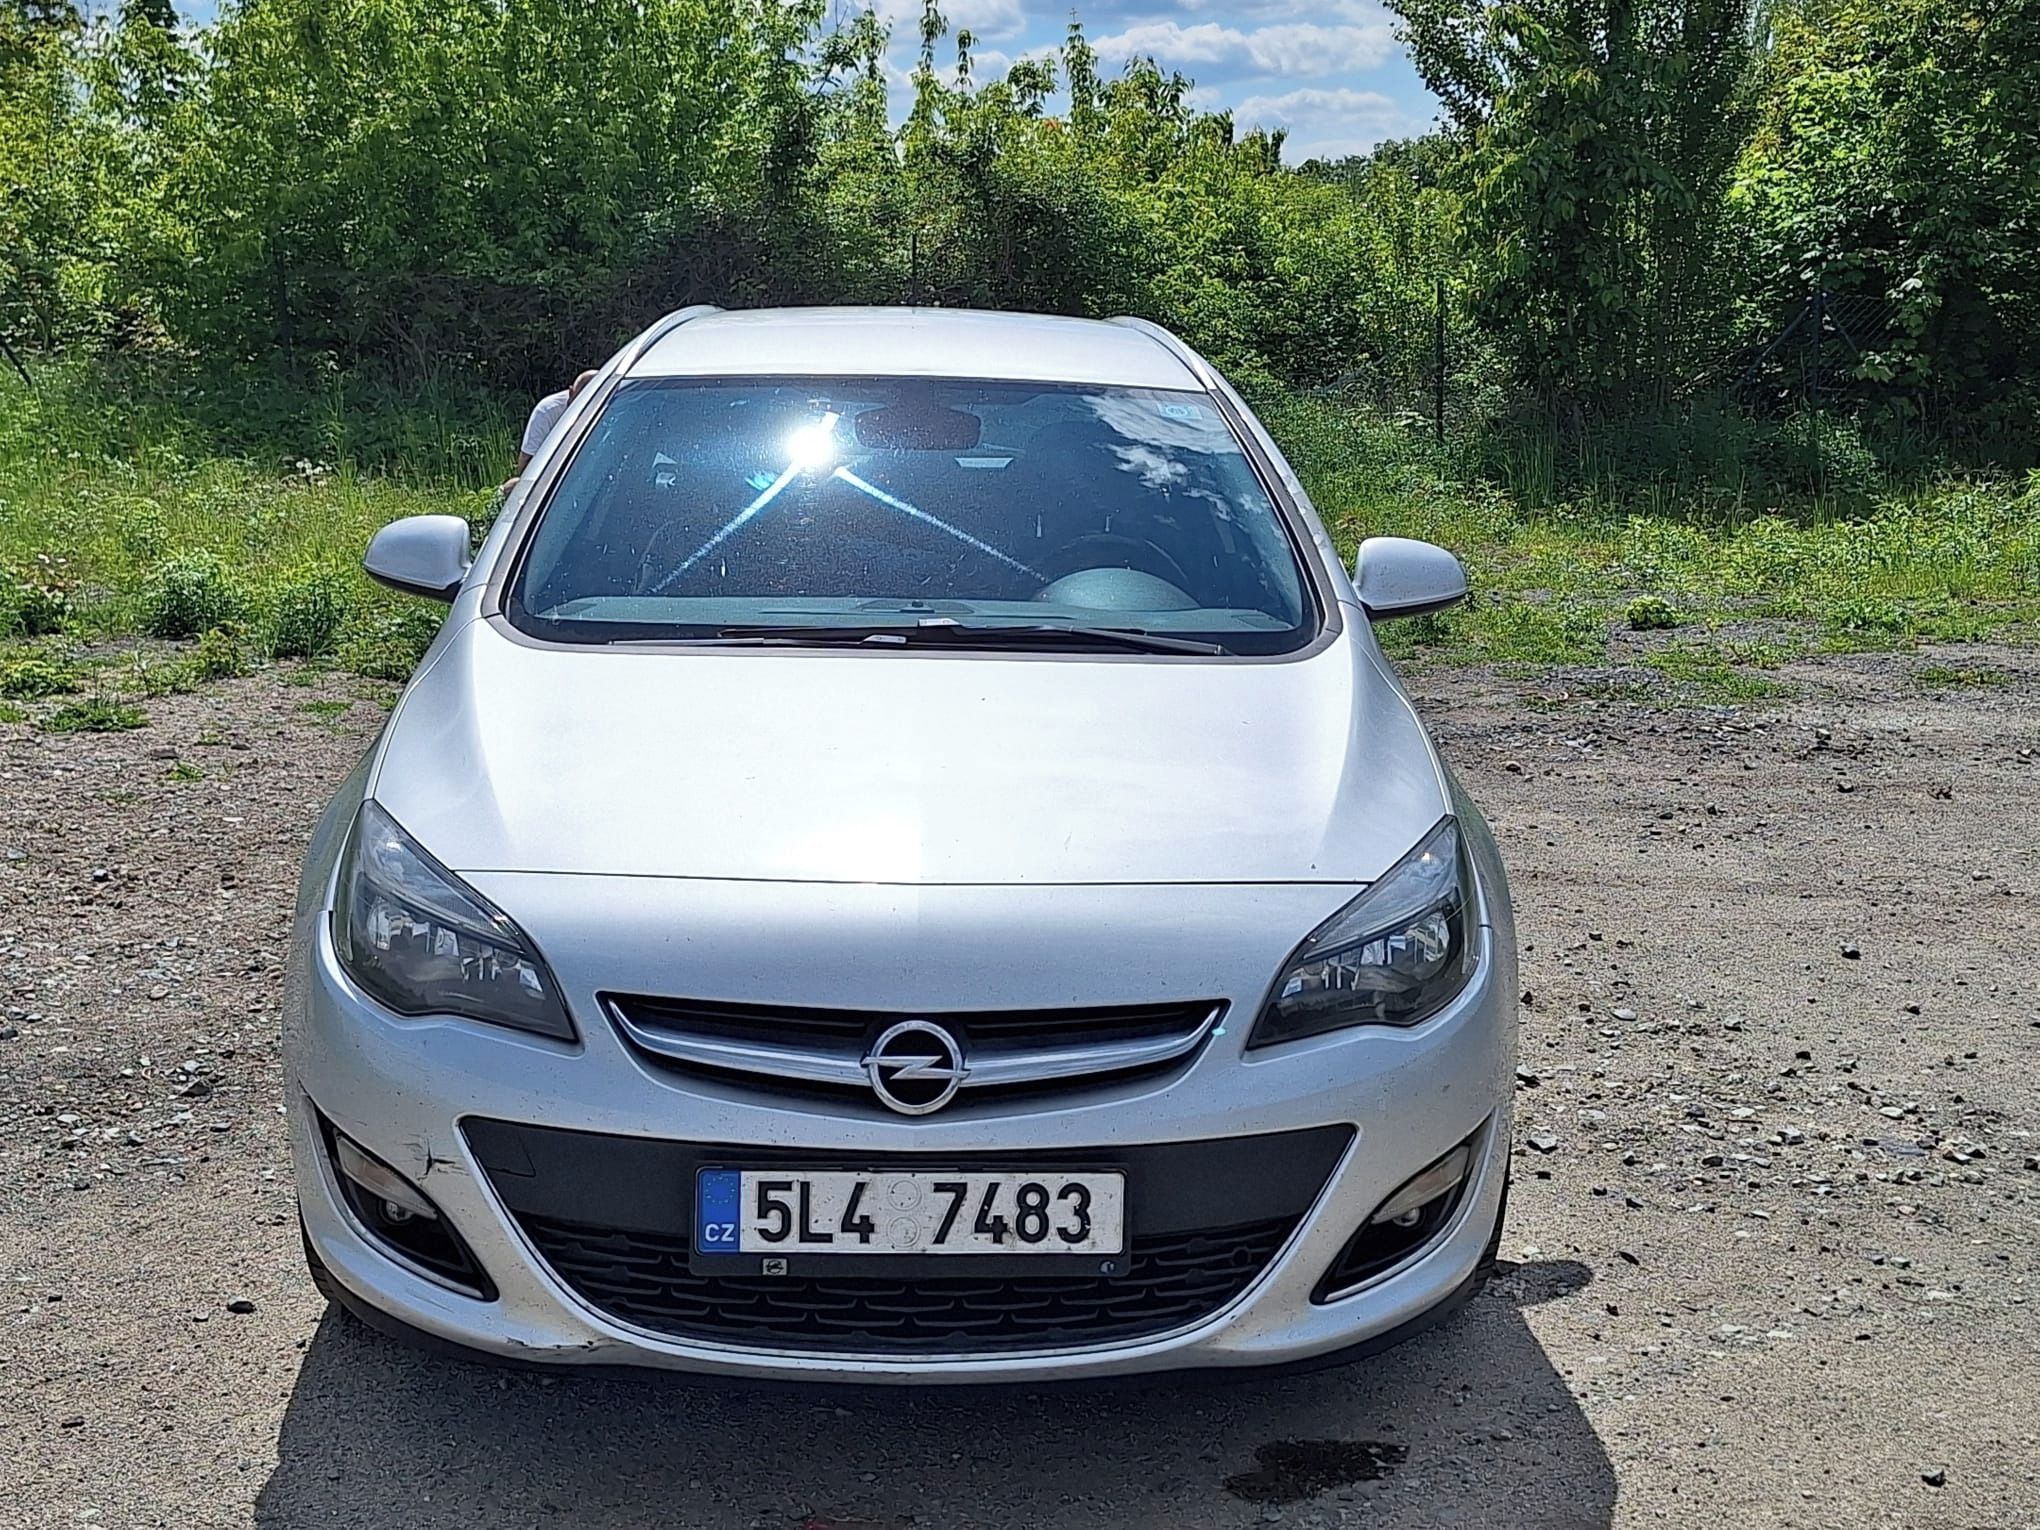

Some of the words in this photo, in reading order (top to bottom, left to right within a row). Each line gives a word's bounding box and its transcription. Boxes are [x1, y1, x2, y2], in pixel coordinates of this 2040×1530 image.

[704, 1222, 735, 1243] CZ
[756, 1180, 875, 1244] 5L4
[931, 1181, 1092, 1245] 7483
